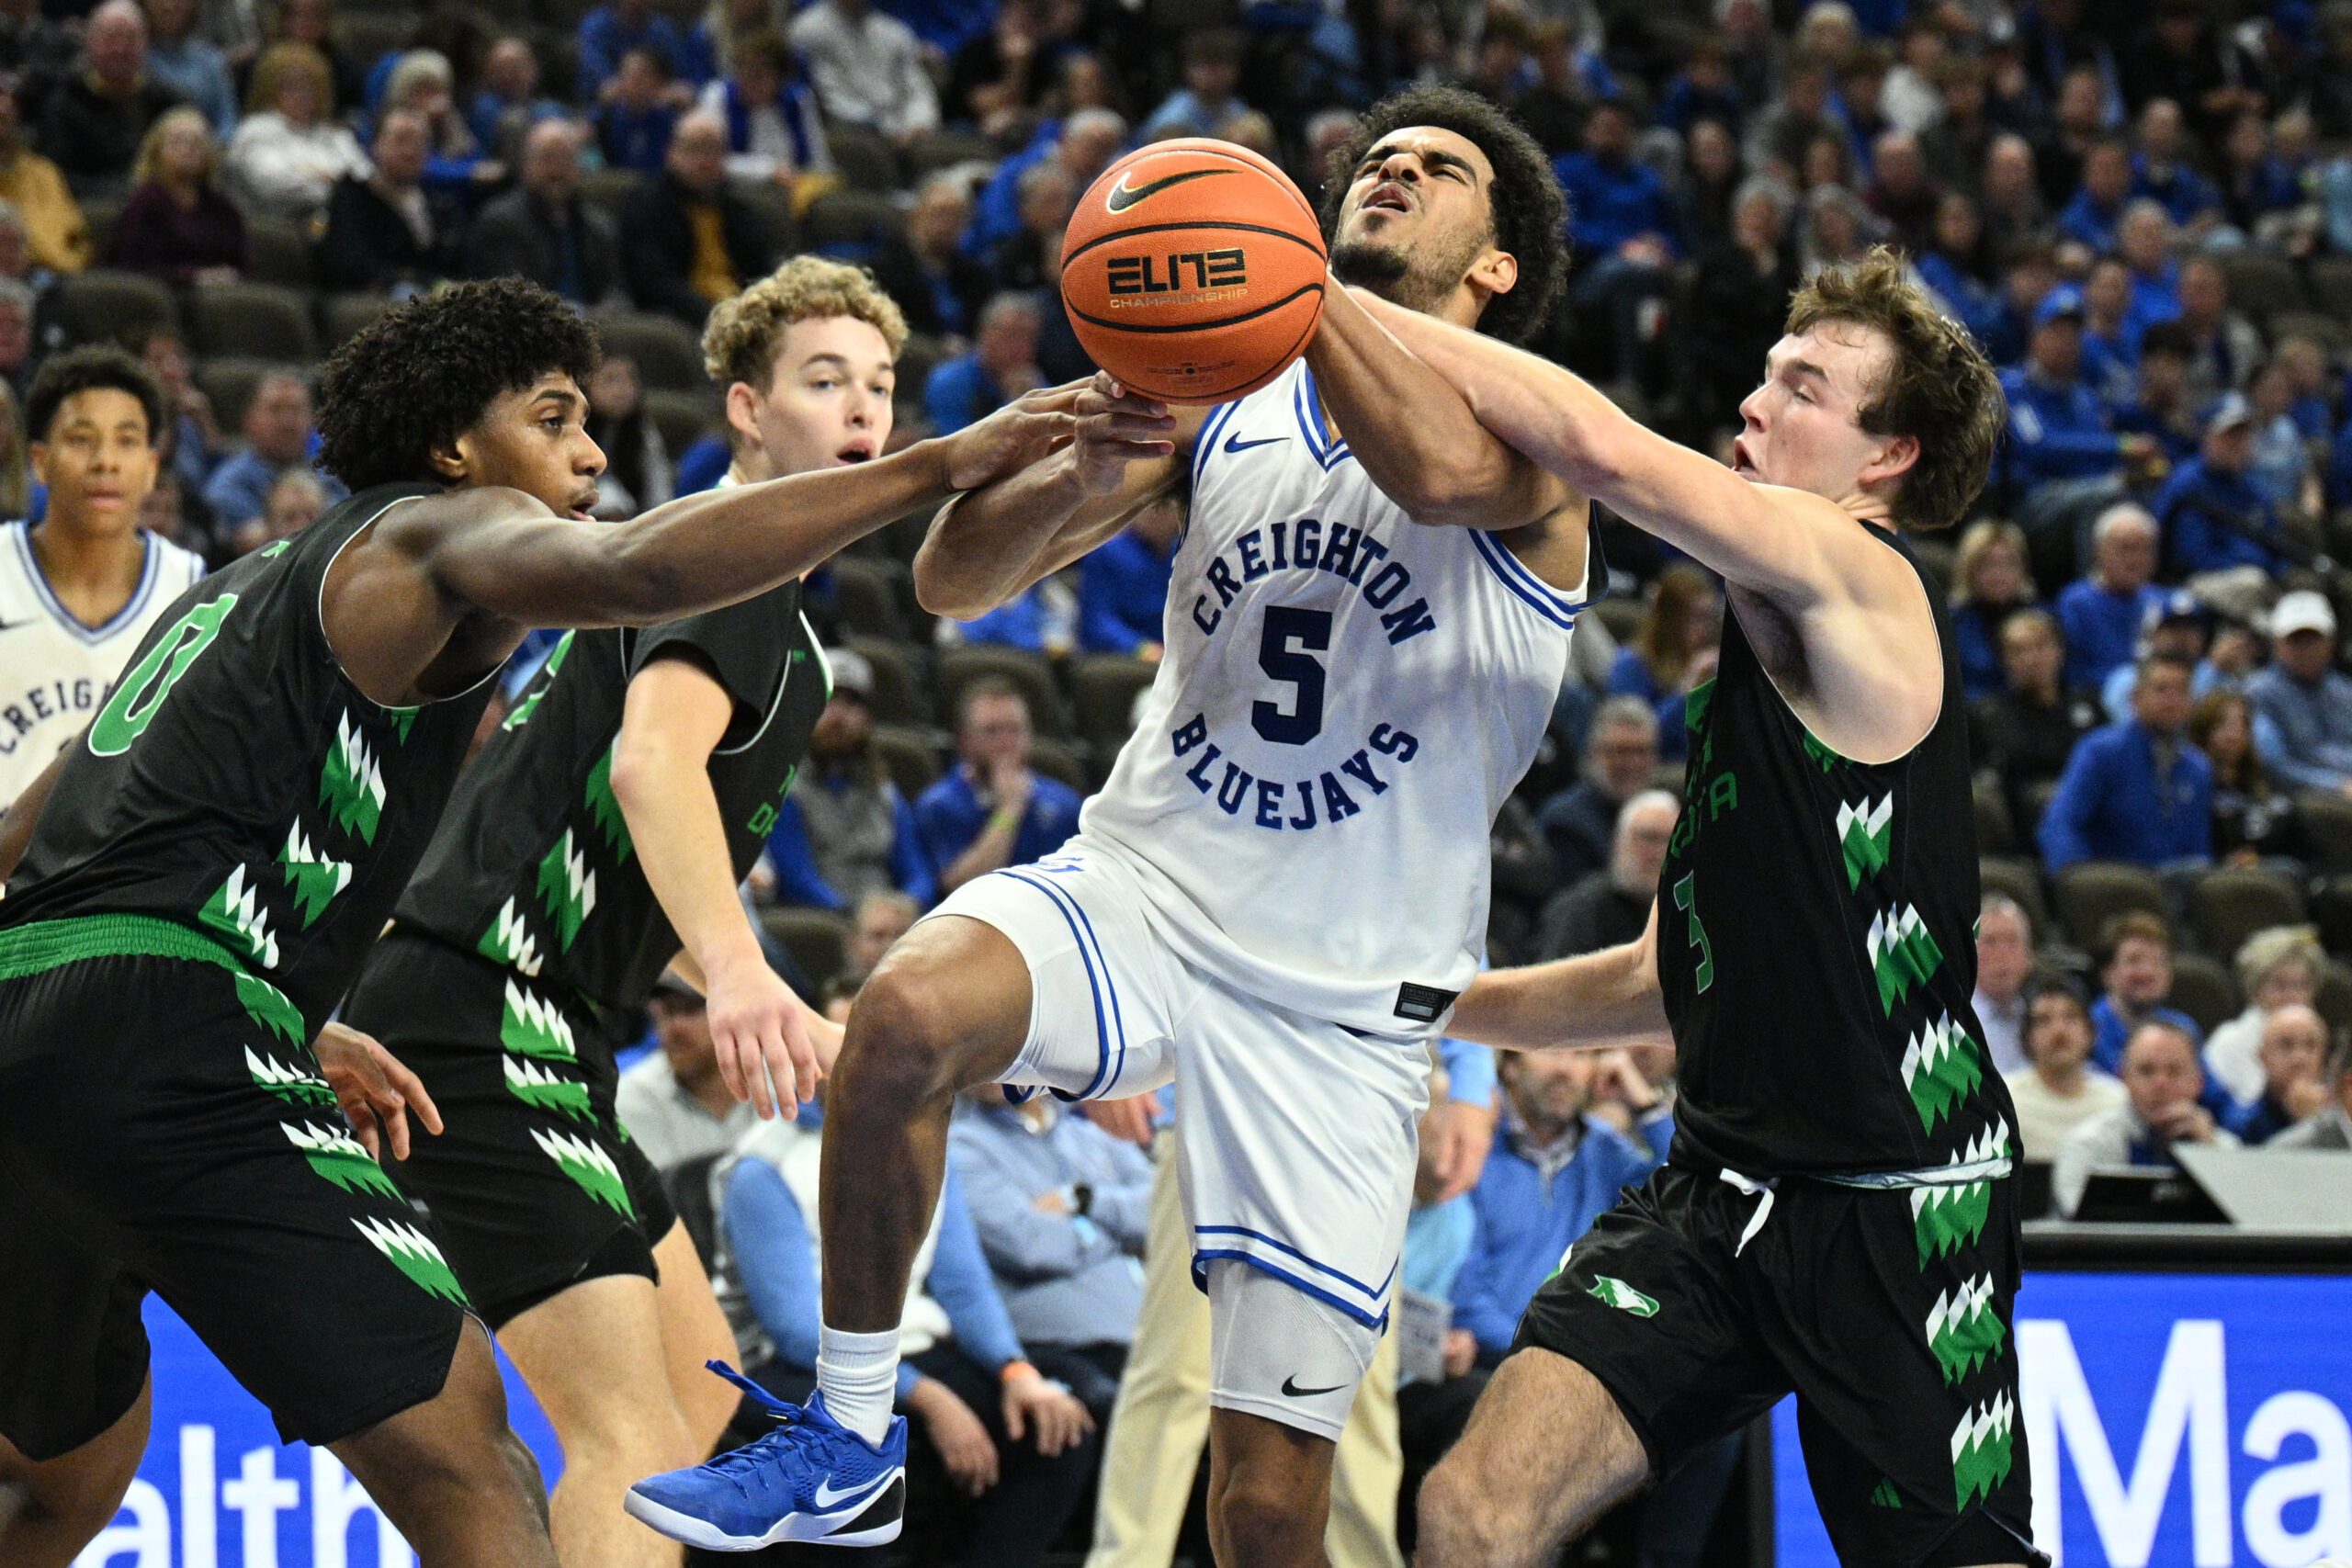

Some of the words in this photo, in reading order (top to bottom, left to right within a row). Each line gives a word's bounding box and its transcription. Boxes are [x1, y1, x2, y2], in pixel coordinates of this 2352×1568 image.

[1106, 247, 1247, 295] ELITE
[1109, 288, 1249, 310] CHAMPIONSHIP
[1193, 518, 1436, 645] CREIGHTON
[0, 678, 112, 754] REIG
[1250, 604, 1332, 746] 5
[1171, 711, 1419, 830] BLUEJAYS
